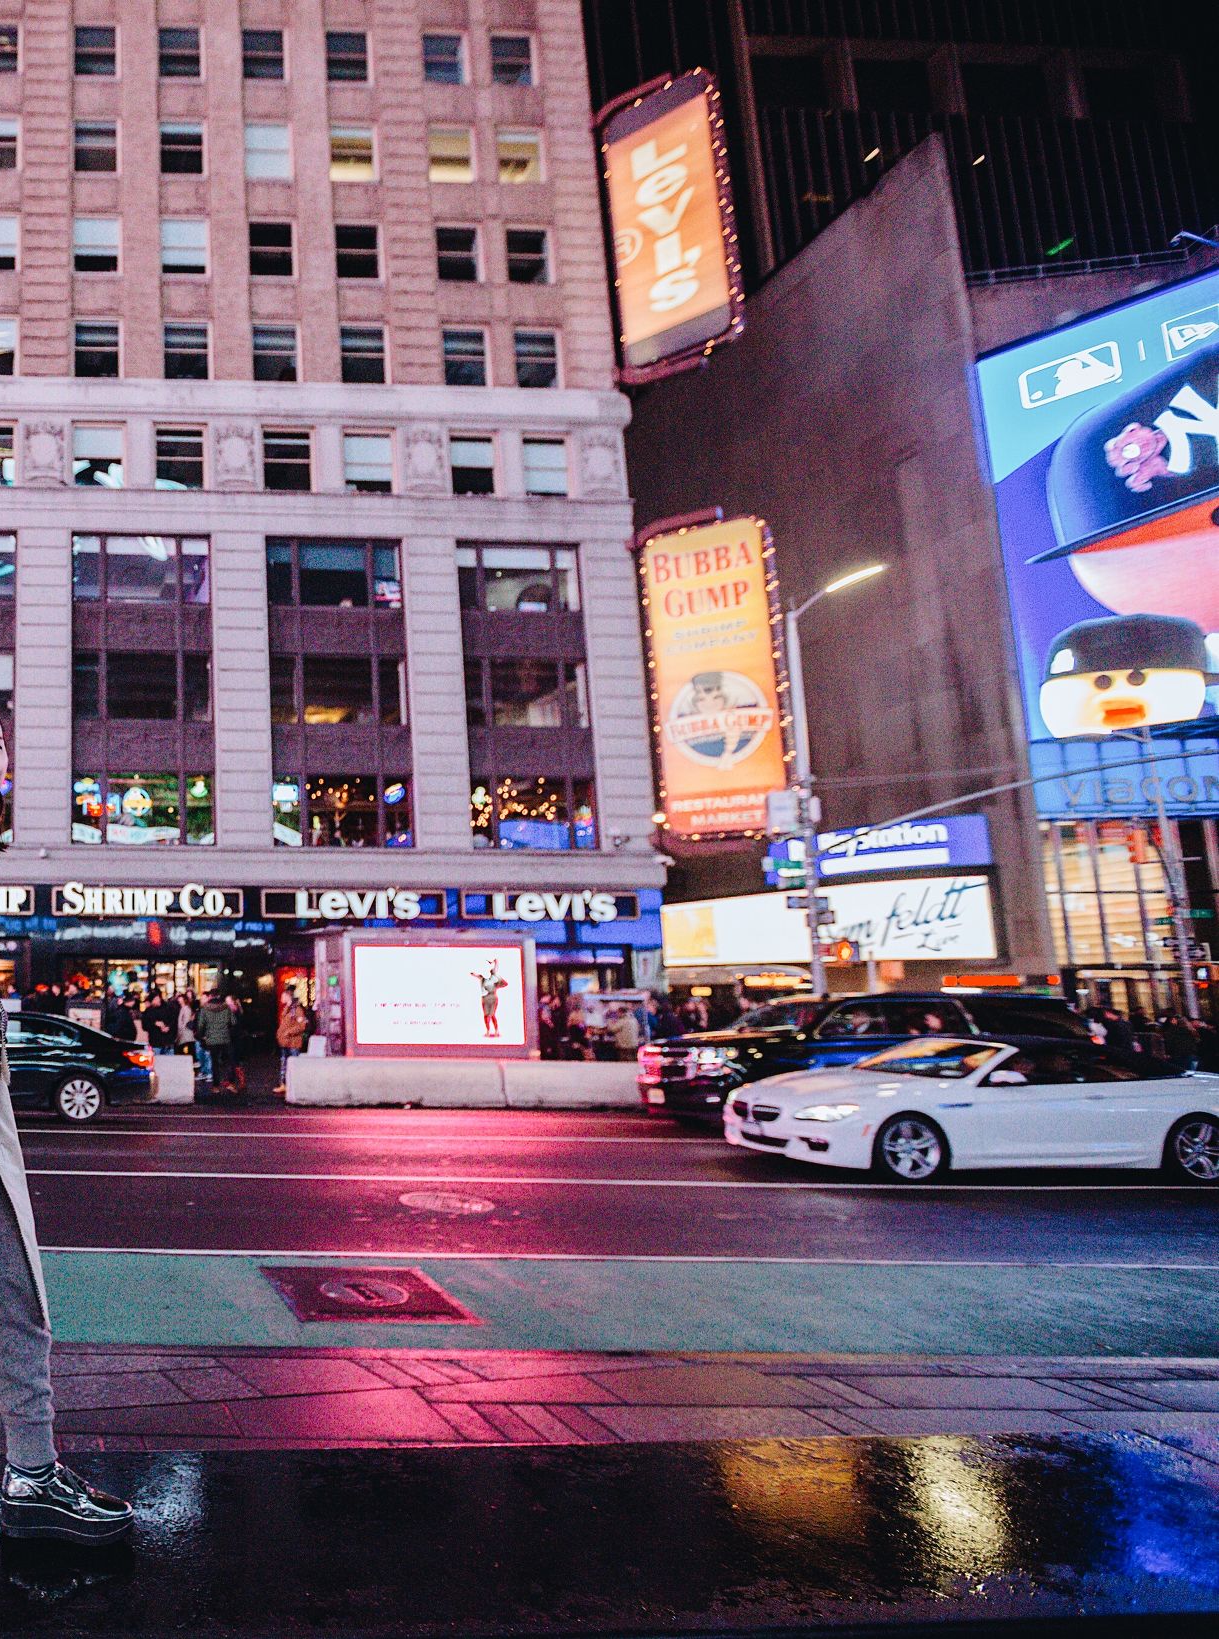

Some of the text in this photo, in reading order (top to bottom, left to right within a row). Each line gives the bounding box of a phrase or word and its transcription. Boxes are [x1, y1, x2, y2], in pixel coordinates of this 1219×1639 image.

[652, 540, 754, 584] BUBBA
[664, 580, 749, 619] GUMP
[670, 793, 767, 814] RESTAURAN
[816, 822, 949, 858] PlayStation
